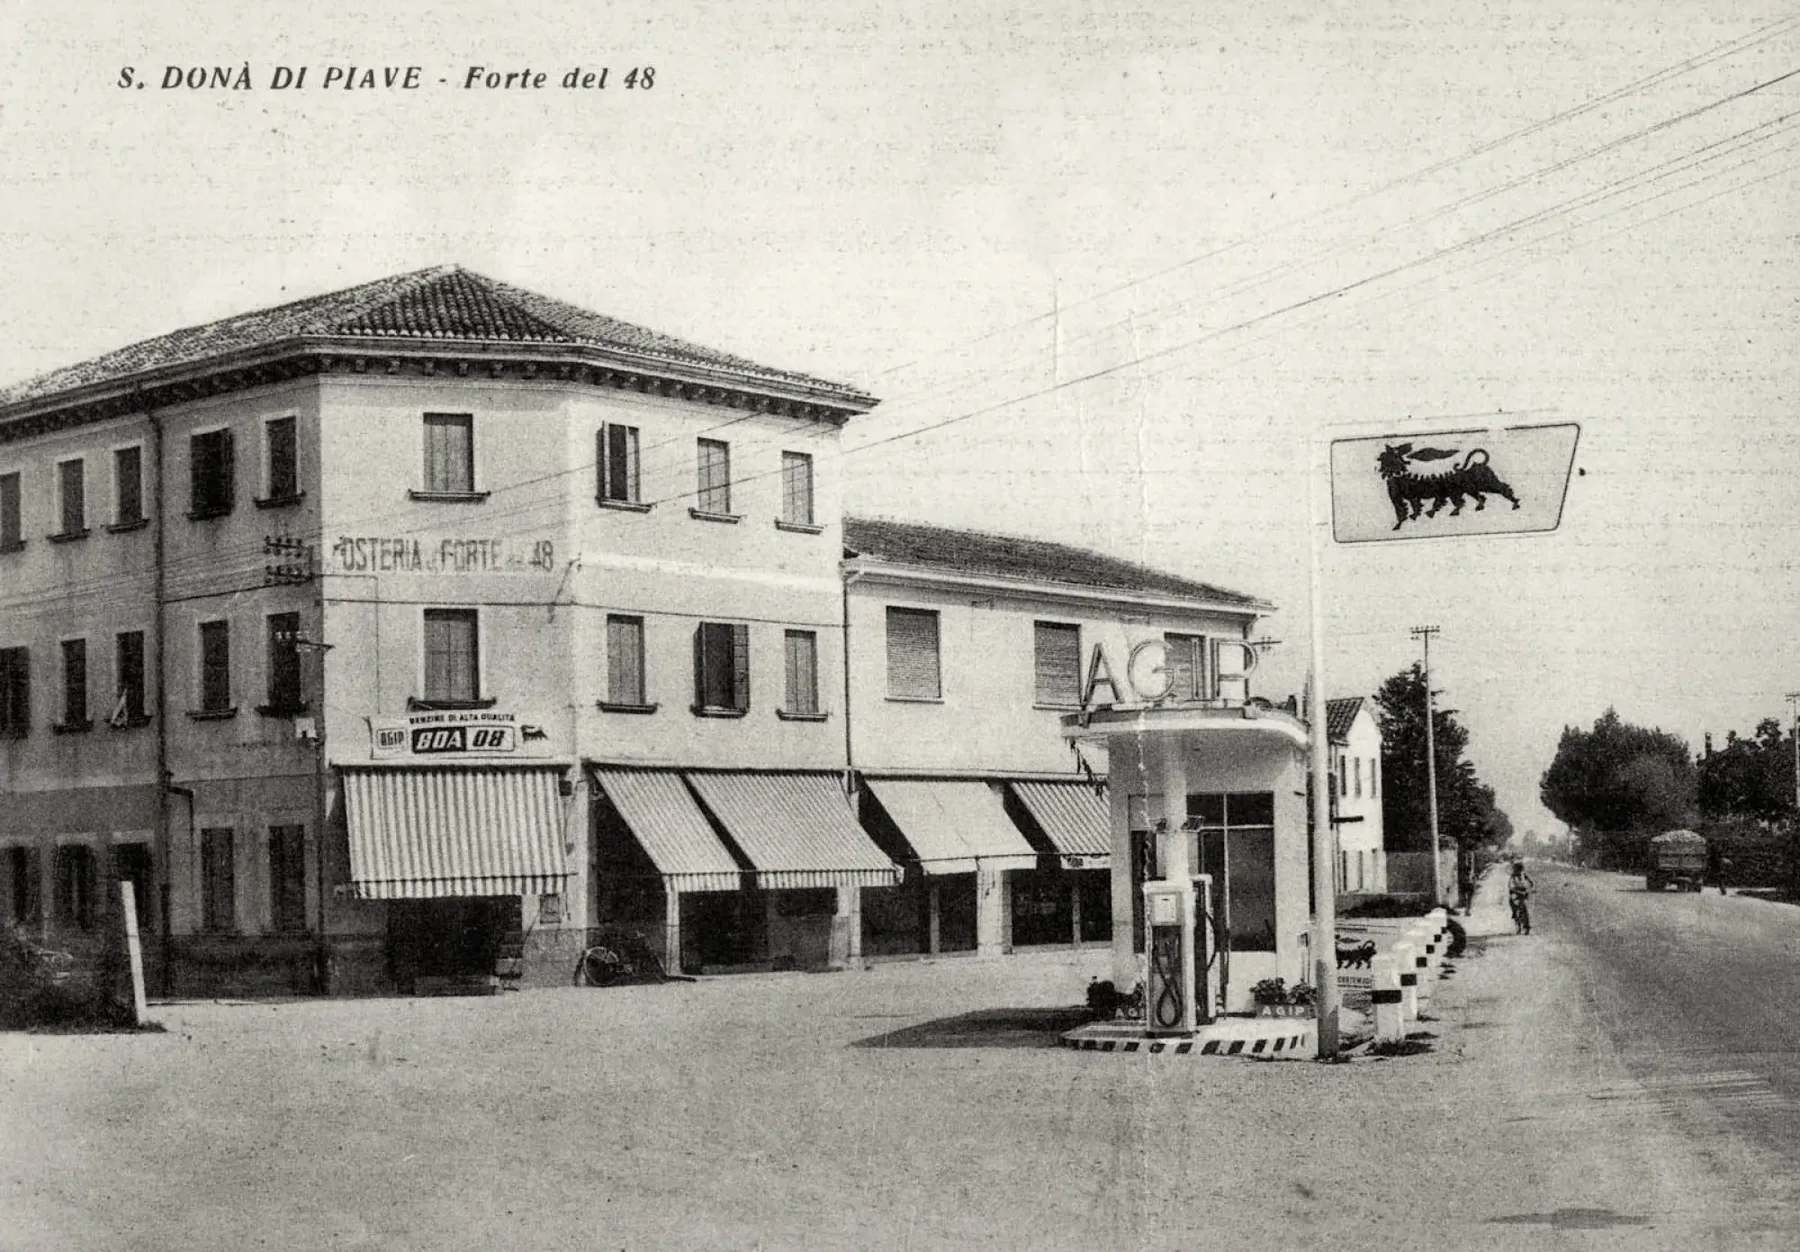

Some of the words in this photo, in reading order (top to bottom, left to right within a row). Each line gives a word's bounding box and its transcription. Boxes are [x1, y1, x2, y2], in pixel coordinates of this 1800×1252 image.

[343, 537, 422, 573] OSTERIA
[440, 538, 503, 573] FORTE
[1080, 637, 1258, 712] AGIP
[380, 730, 404, 746] AGIP
[1262, 1005, 1305, 1016] AGIP
